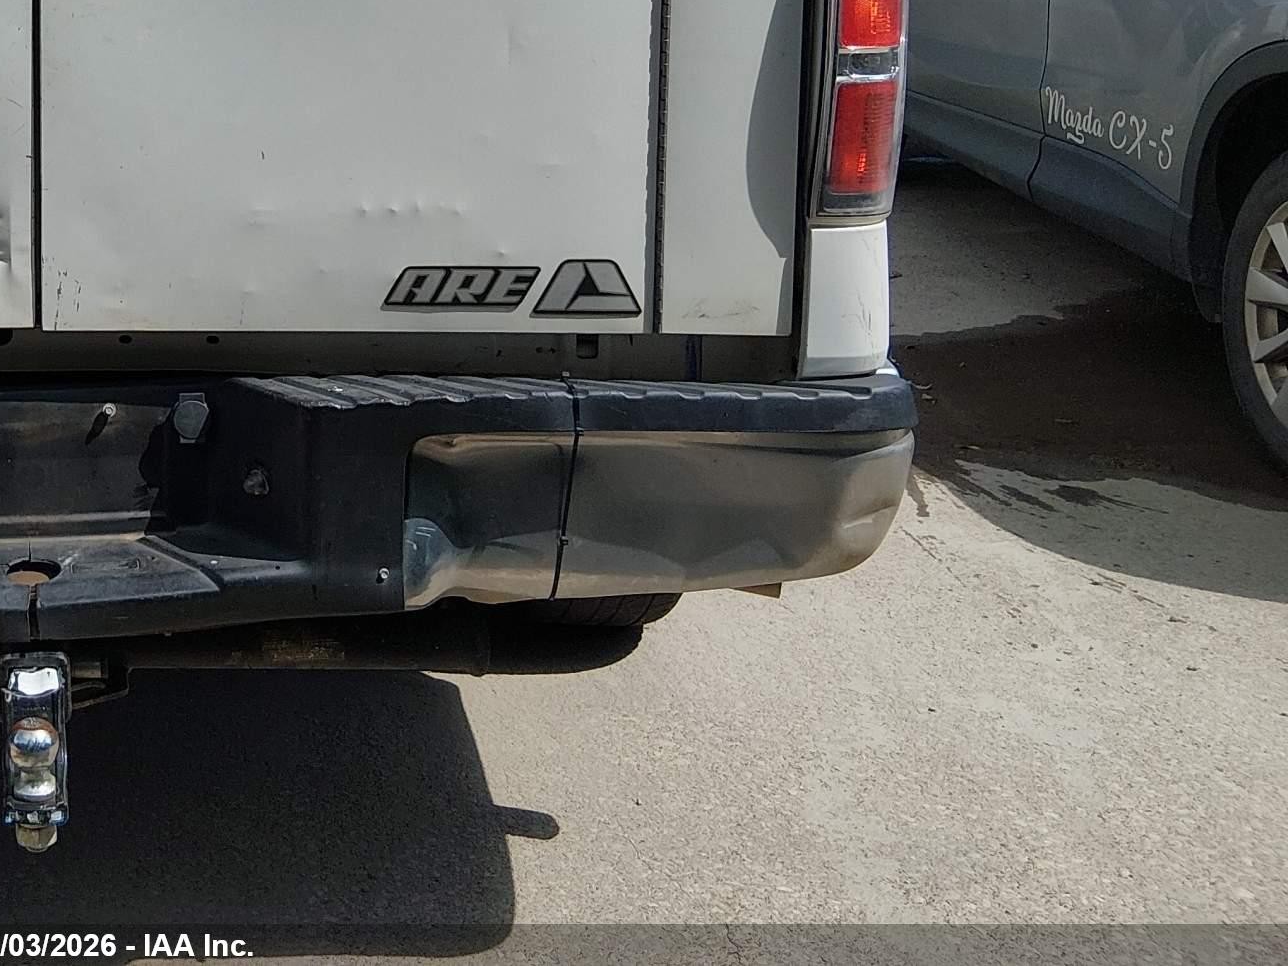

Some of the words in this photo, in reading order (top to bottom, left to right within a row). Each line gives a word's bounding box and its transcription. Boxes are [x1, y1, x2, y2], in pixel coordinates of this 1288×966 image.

[1045, 86, 1105, 144] Mazda
[1109, 110, 1174, 170] CX-5
[383, 266, 541, 307] ARE
